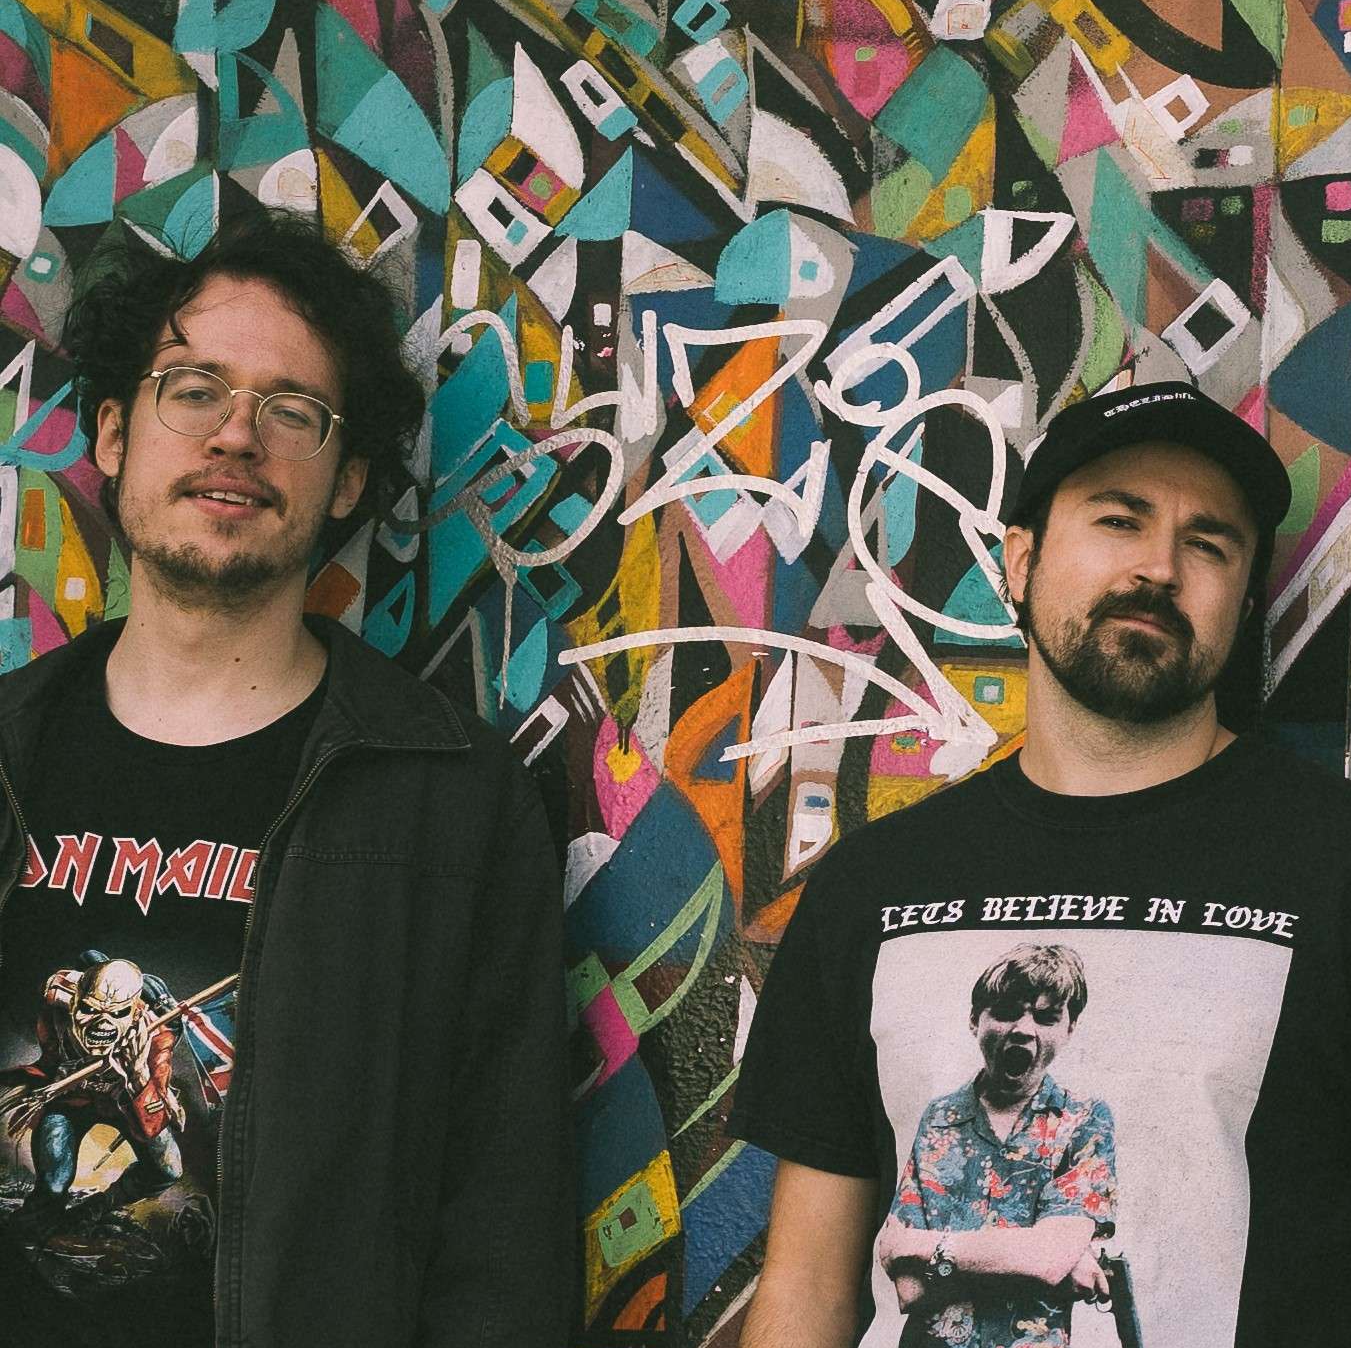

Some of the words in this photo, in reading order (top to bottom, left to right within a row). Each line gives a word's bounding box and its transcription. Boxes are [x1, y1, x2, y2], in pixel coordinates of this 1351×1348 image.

[105, 837, 260, 917] MAID
[880, 898, 966, 933] LETS
[980, 894, 1130, 922] BELIEVE
[1144, 897, 1187, 924] IN
[1201, 902, 1300, 939] LOVE
